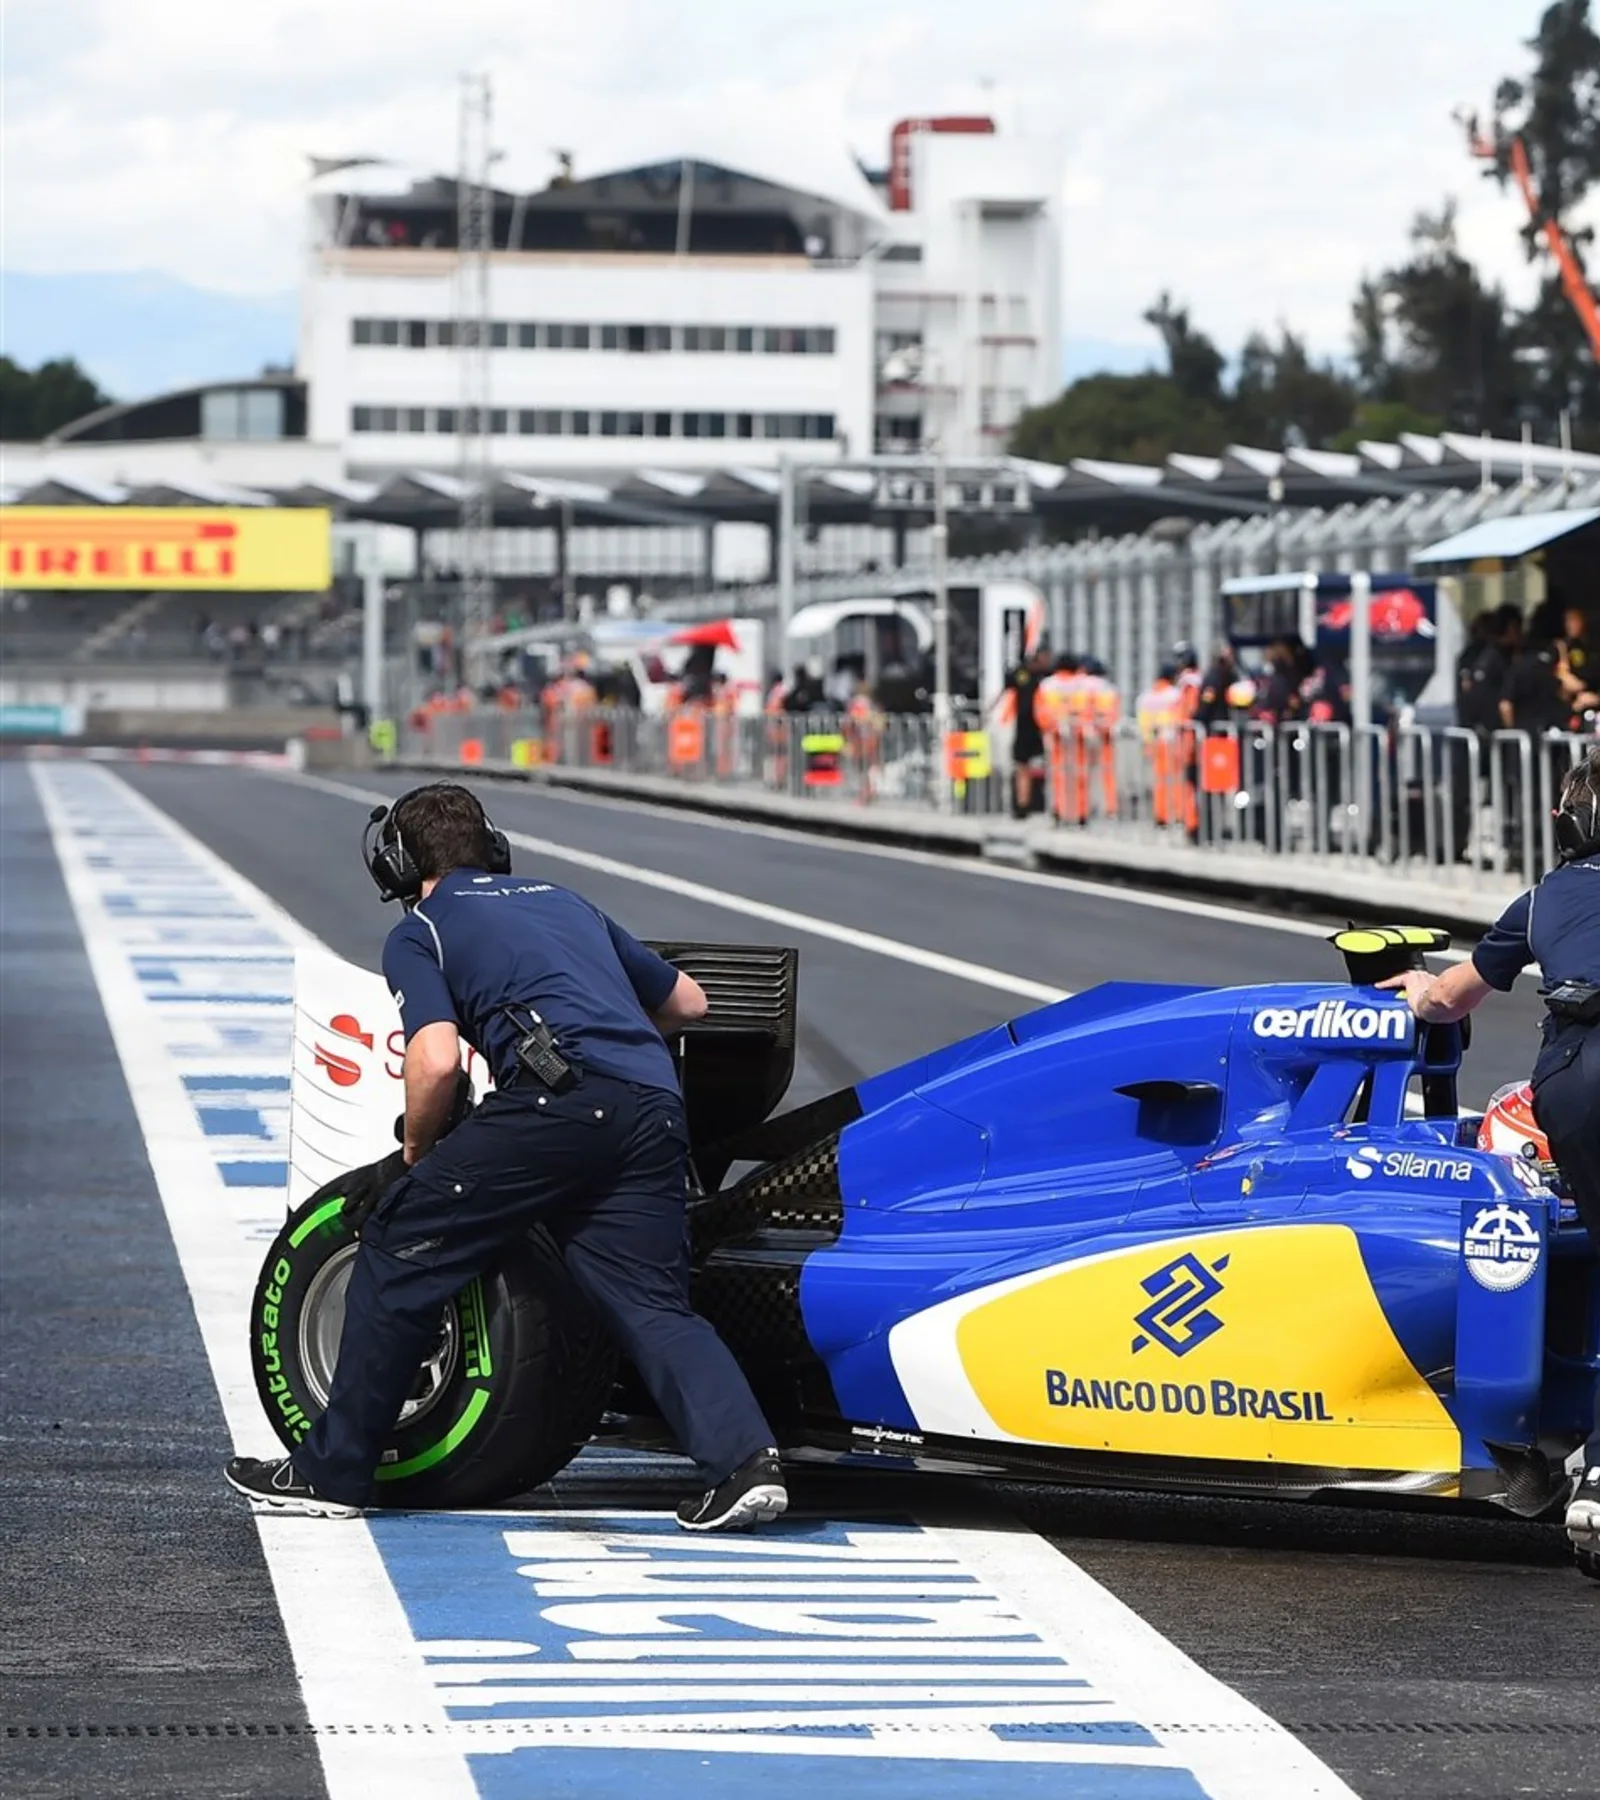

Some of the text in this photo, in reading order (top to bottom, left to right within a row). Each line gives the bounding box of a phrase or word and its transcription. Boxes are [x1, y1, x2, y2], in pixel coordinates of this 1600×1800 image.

[1464, 1240, 1540, 1260] Emil Frey
[1046, 1369, 1334, 1421] BANCO DO BRASIL
[416, 1530, 1187, 1769] Allianz
